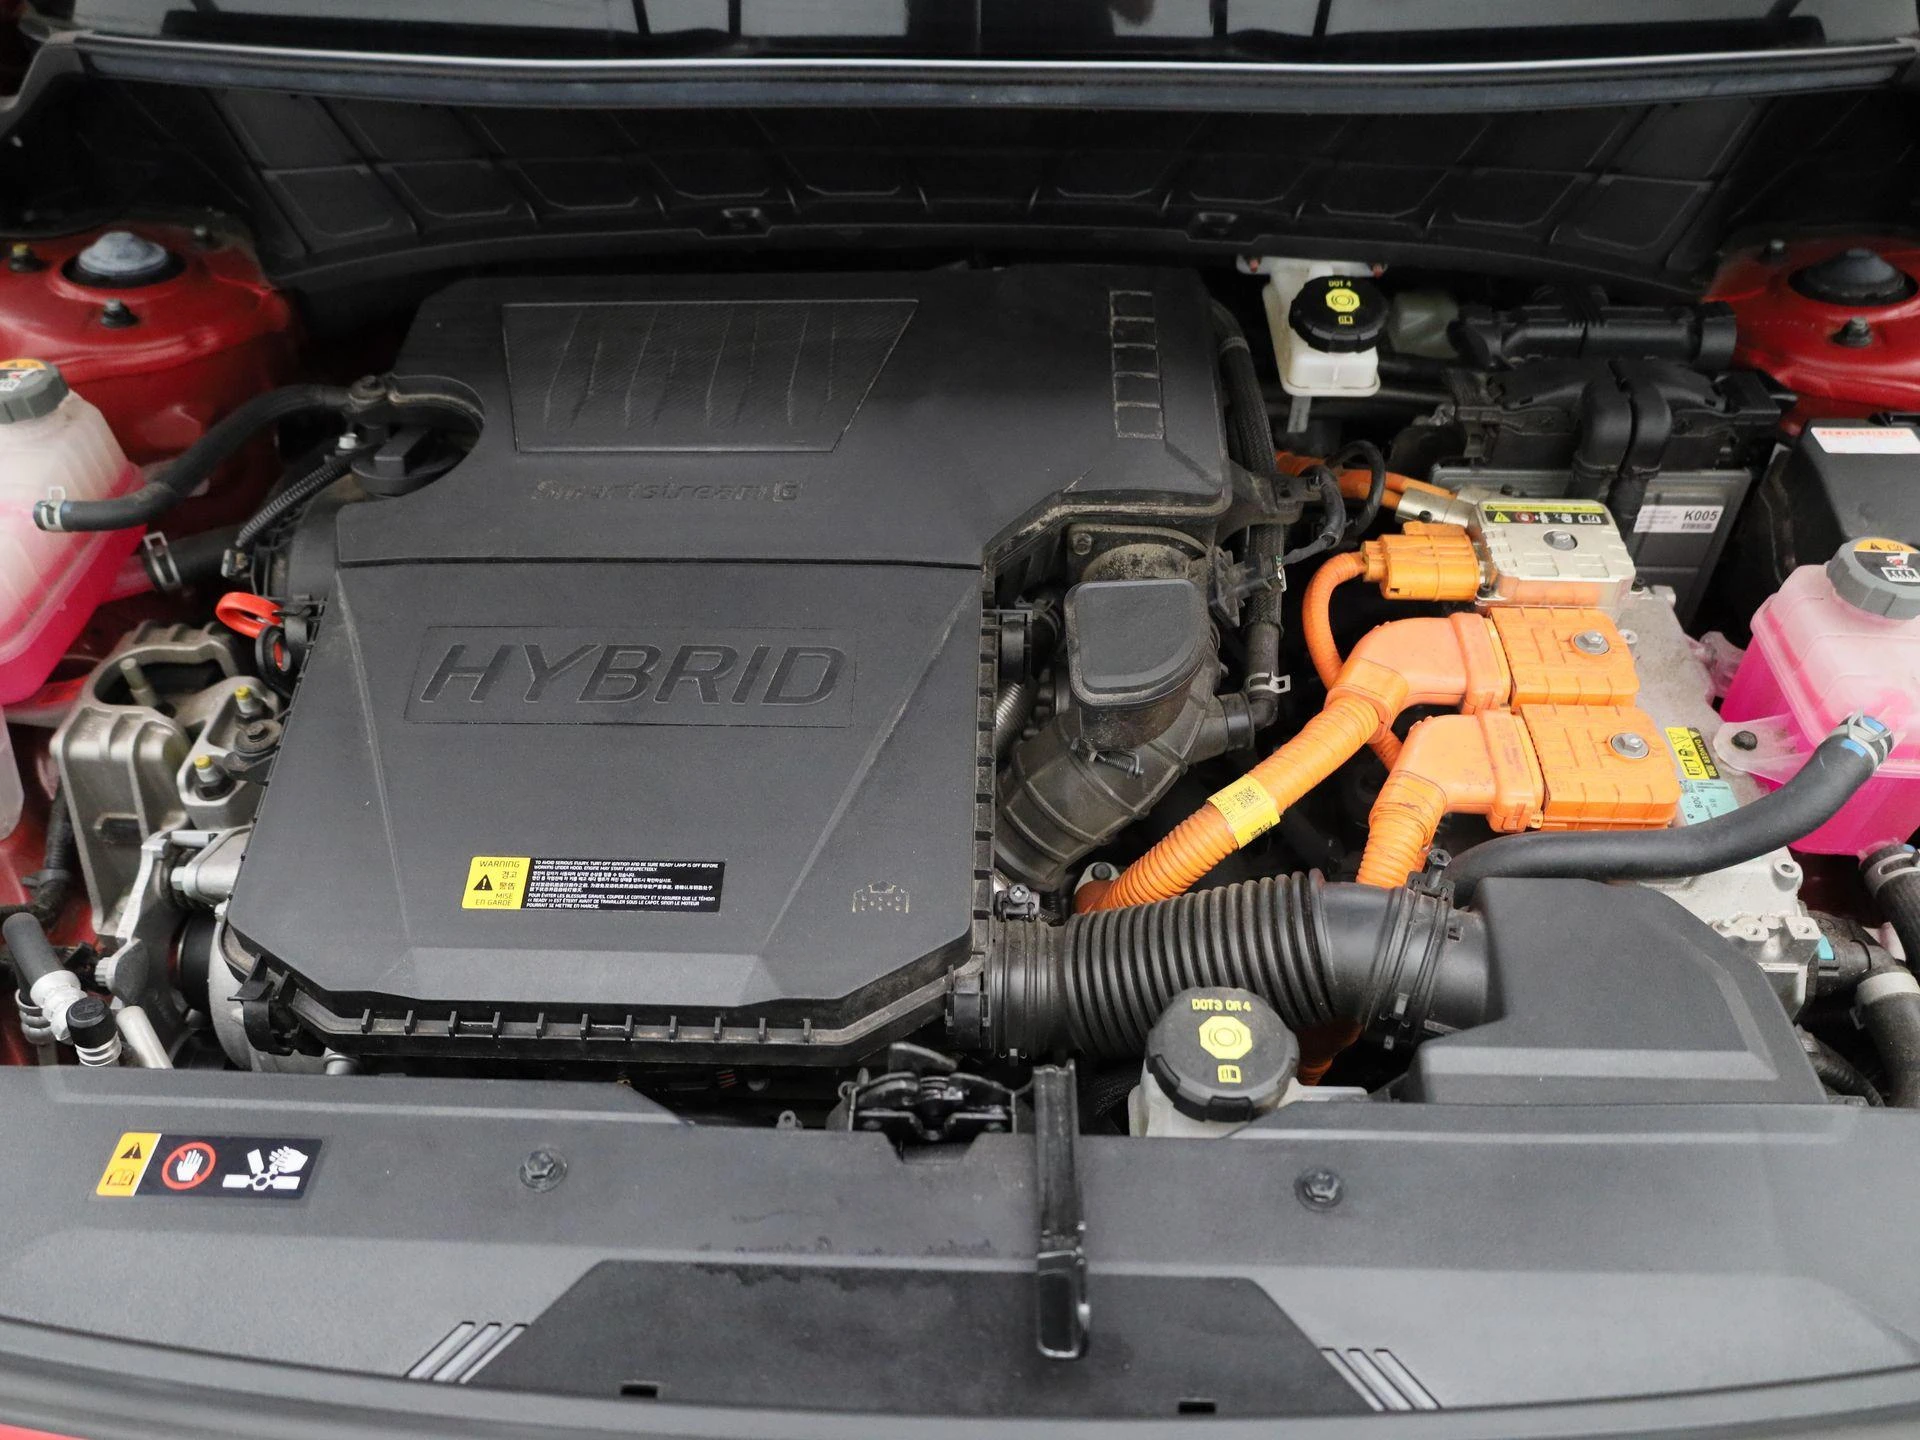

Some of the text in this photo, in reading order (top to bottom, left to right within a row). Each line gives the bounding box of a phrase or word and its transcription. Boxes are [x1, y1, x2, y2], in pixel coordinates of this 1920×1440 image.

[1684, 510, 1719, 521] K005
[418, 643, 847, 706] HYBRID
[1694, 739, 1711, 765] DANGER
[479, 860, 521, 868] WARNING
[501, 871, 517, 879] 경고
[1225, 999, 1242, 1011] OR
[1243, 1001, 1252, 1012] 4
